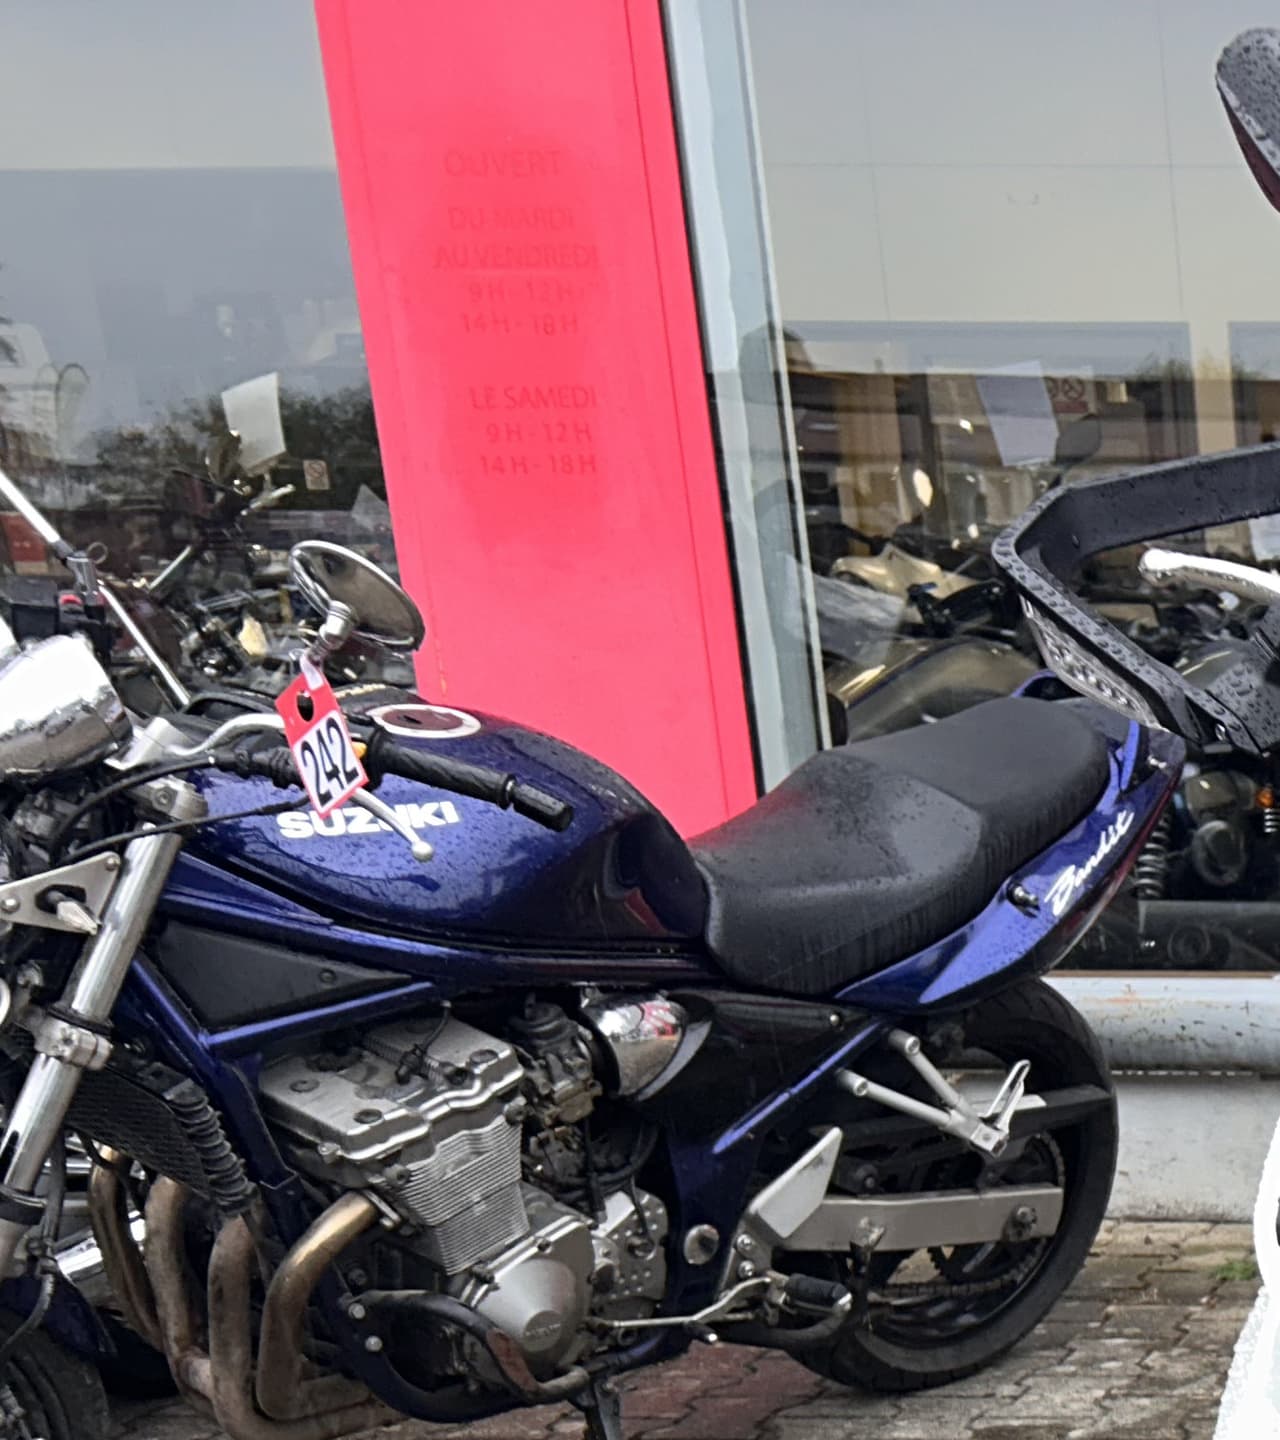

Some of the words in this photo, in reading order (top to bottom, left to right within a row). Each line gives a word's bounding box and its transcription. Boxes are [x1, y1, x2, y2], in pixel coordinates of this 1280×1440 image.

[503, 385, 598, 410] SAMEDI
[300, 717, 360, 806] 242
[276, 801, 460, 839] SUZKI
